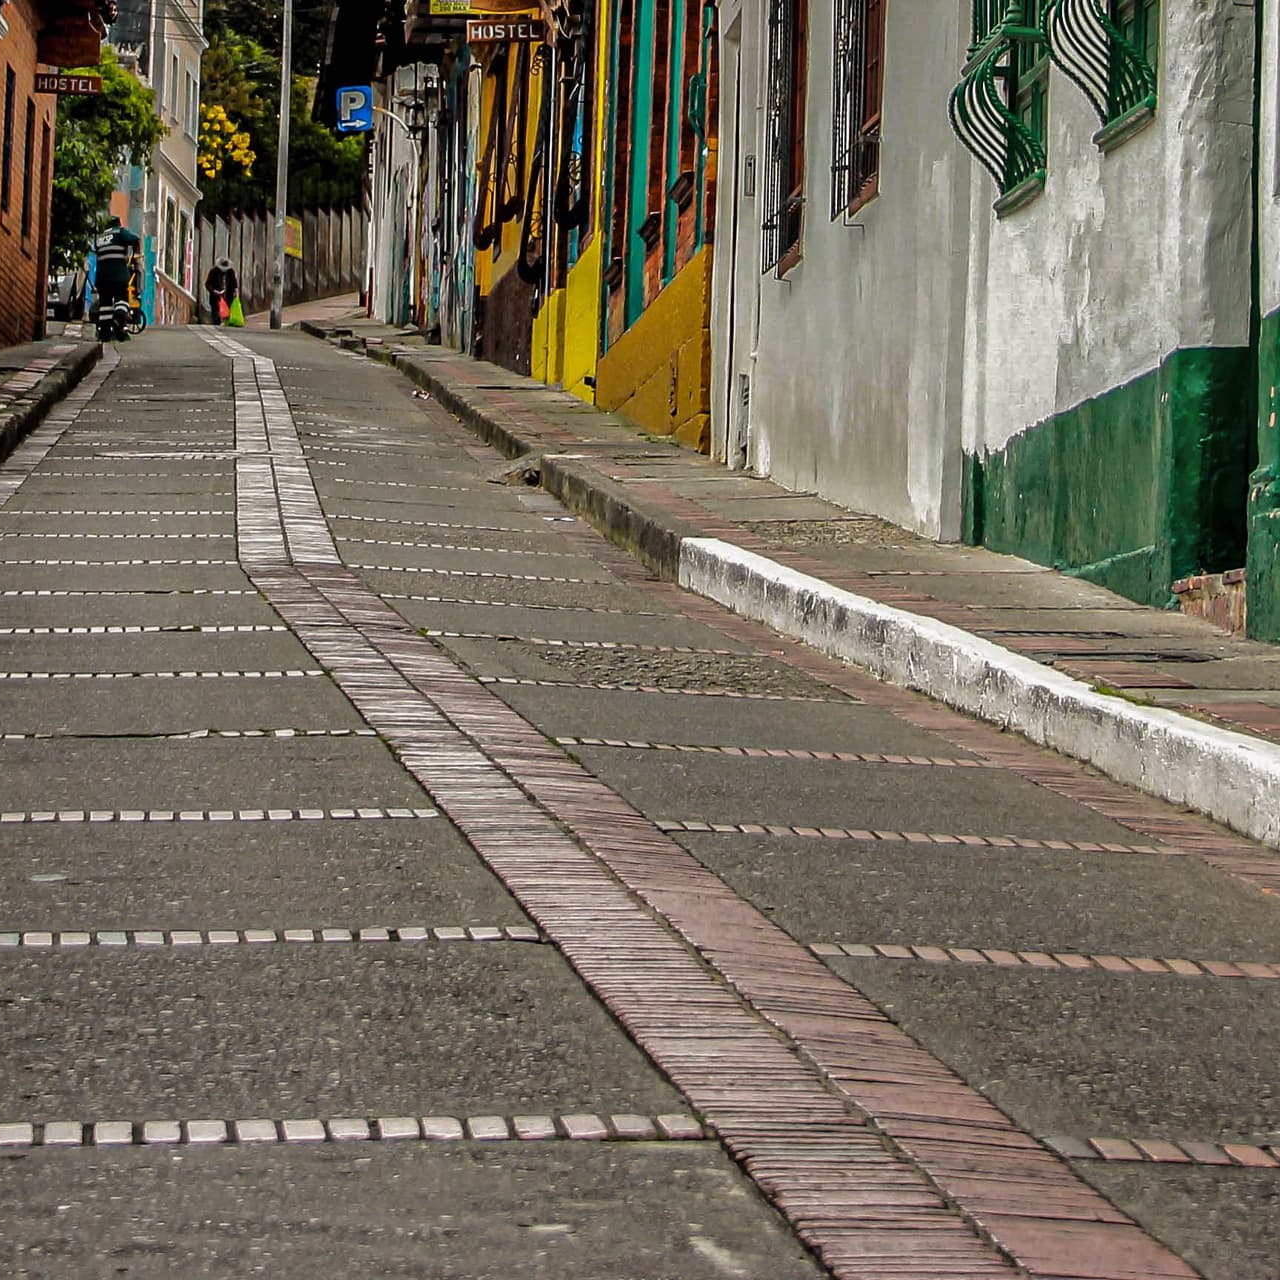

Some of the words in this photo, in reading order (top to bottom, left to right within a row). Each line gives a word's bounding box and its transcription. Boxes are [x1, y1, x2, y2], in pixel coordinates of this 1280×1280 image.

[471, 24, 540, 39] HOSTEL
[38, 77, 99, 92] HOSTEL
[341, 91, 366, 121] P
